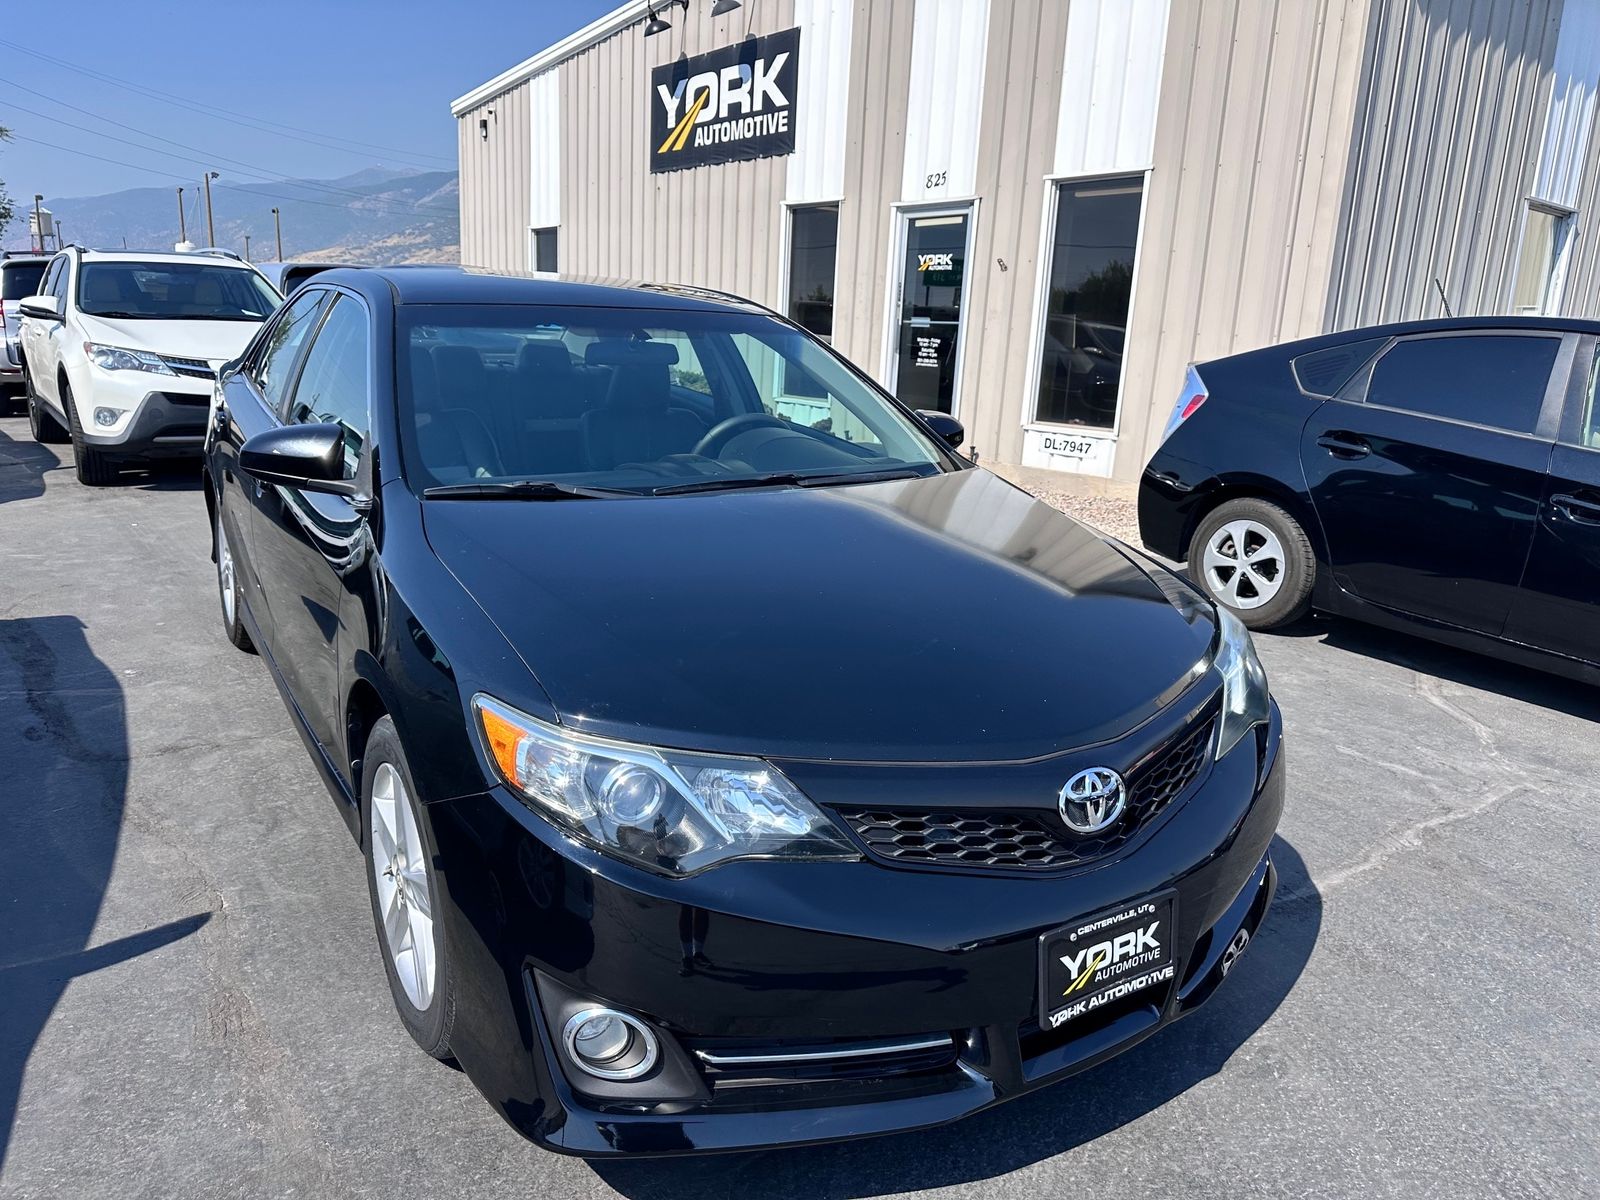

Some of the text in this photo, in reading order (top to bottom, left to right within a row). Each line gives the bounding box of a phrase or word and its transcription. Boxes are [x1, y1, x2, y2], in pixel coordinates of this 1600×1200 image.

[657, 52, 790, 129] YORK
[694, 111, 789, 147] AUTOMOTIVE
[926, 170, 947, 189] 825
[918, 254, 953, 266] YORK
[1044, 438, 1092, 454] DL:7947
[1077, 903, 1149, 936] CENTERVILLE, UT
[1060, 921, 1161, 980] YORK
[1095, 948, 1161, 982] AUTOMOTIVE
[1088, 966, 1174, 1009] AUTOMOTIVE
